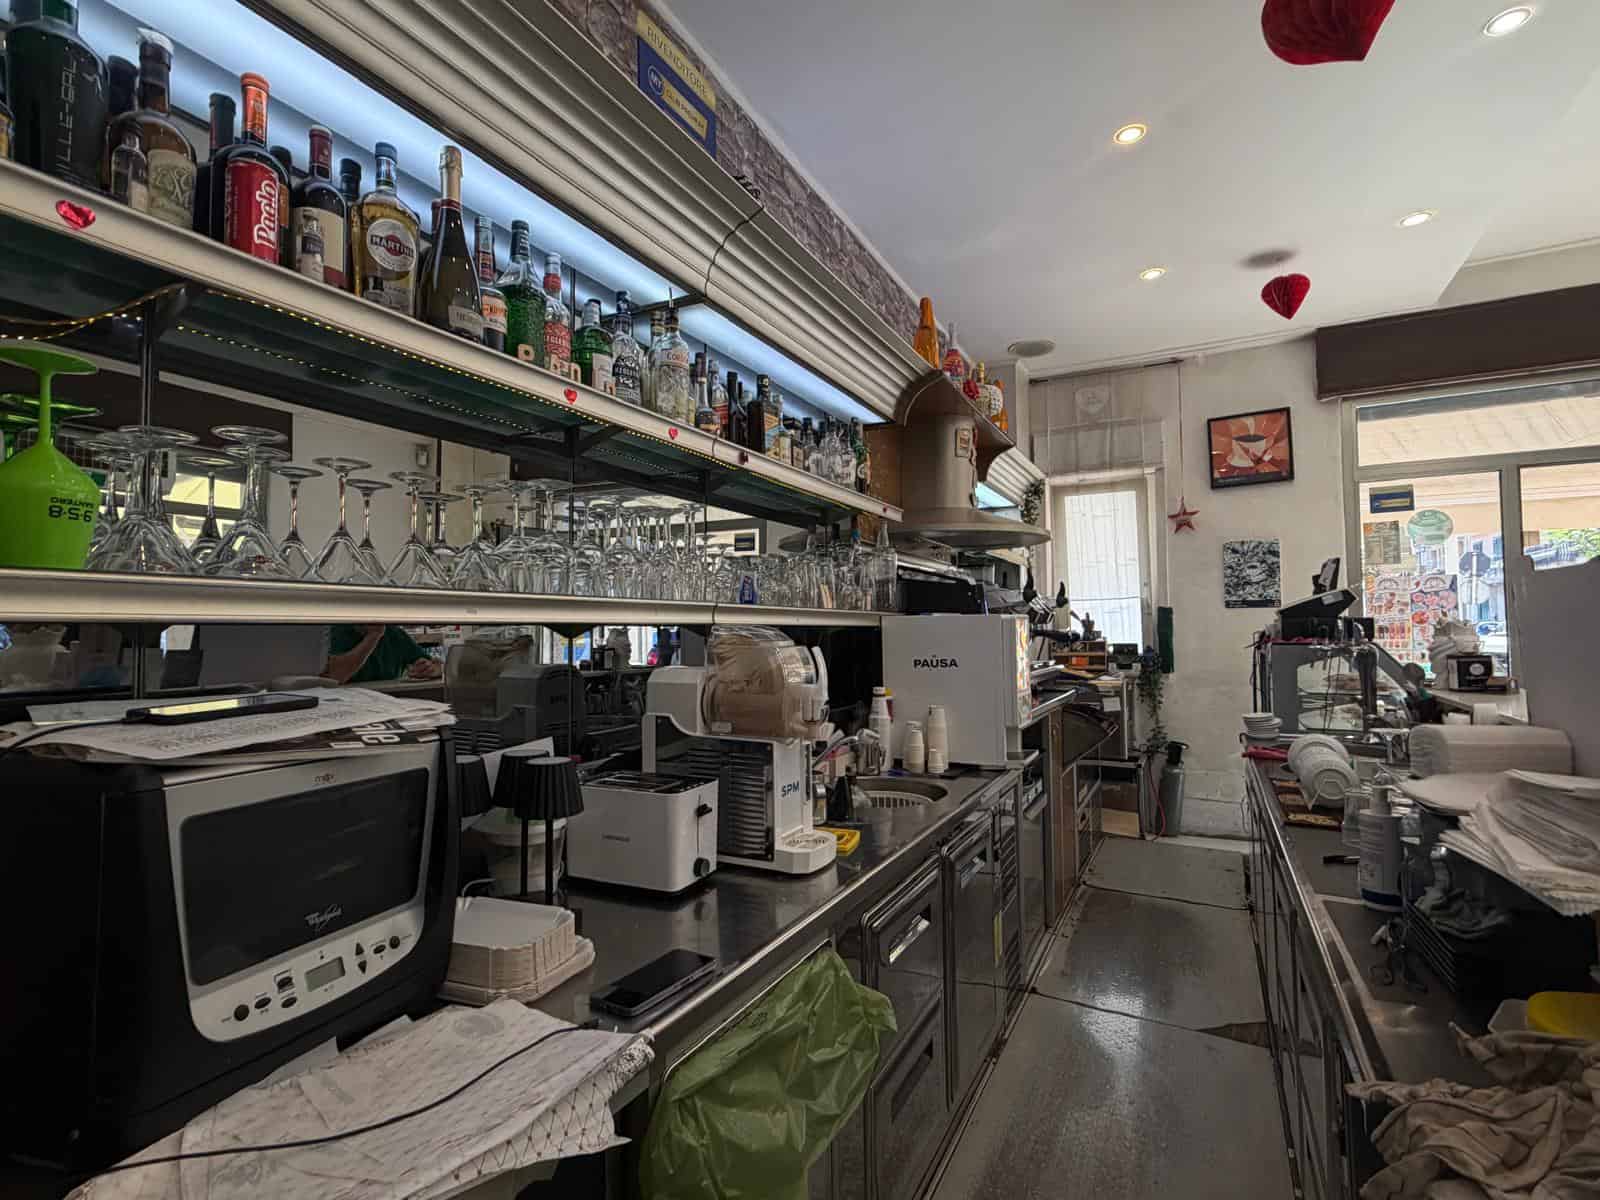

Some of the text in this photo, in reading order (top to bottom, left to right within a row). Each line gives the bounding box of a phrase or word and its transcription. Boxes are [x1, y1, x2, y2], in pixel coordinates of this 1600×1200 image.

[647, 25, 708, 97] RIVENDITORE
[370, 234, 414, 259] MARTINI
[782, 781, 800, 798] SPM
